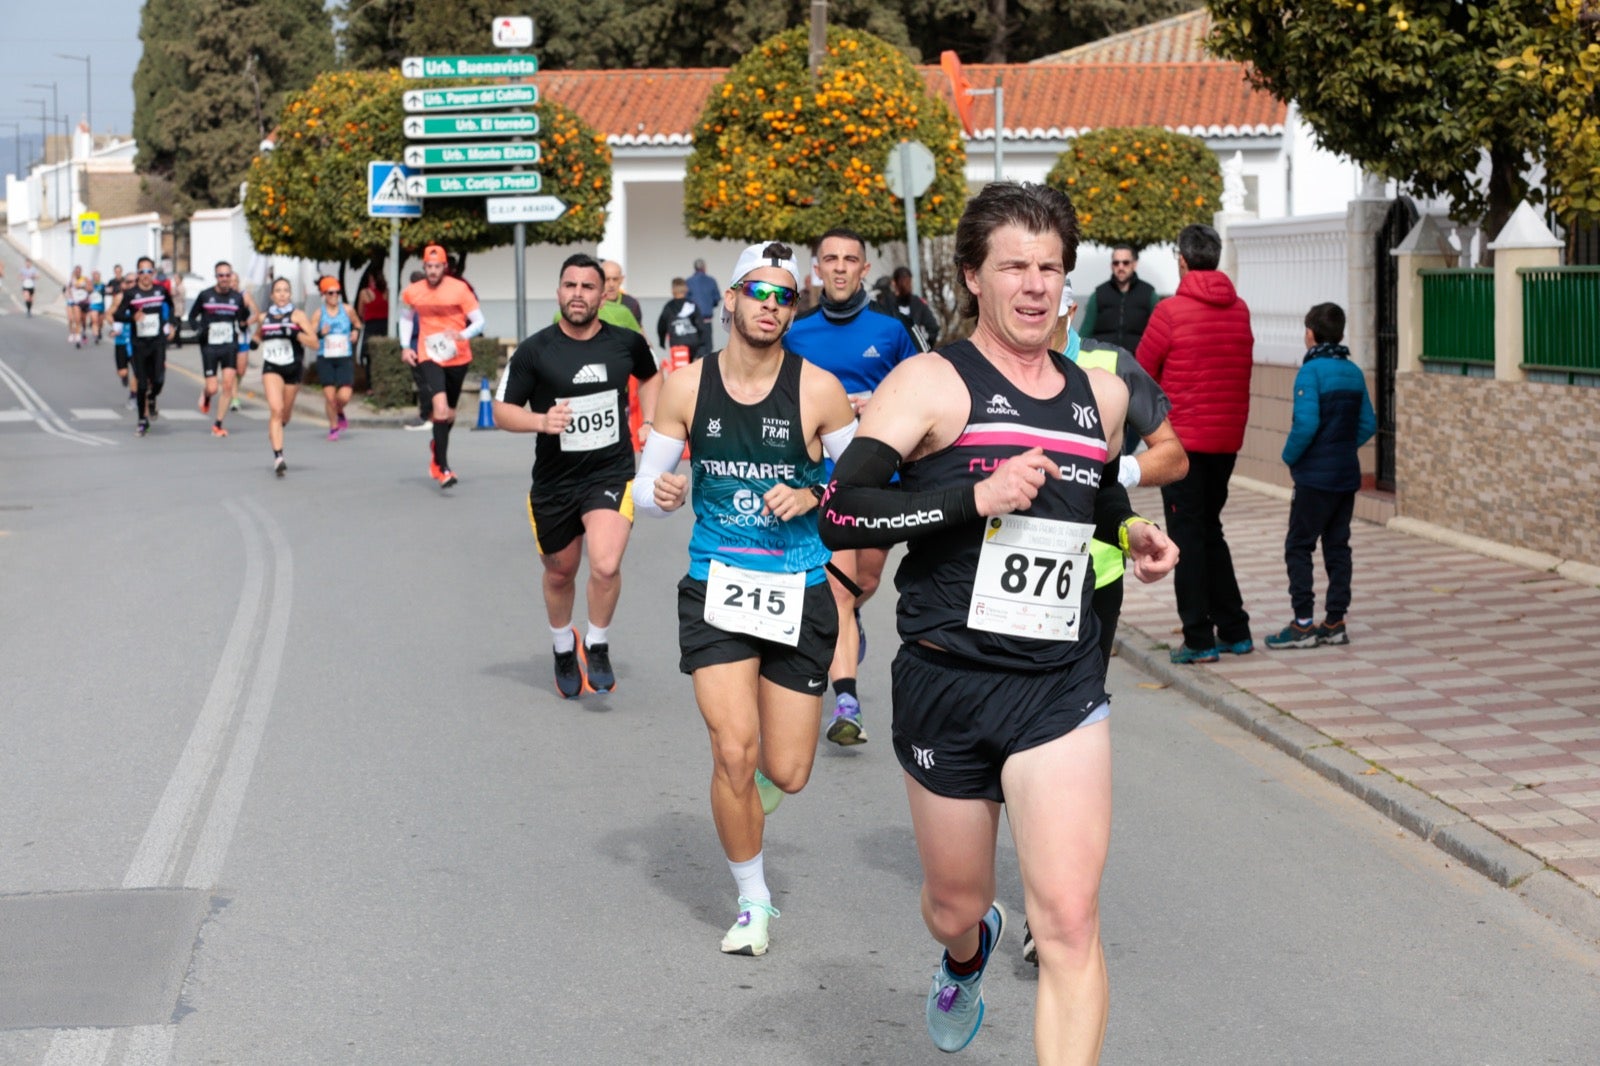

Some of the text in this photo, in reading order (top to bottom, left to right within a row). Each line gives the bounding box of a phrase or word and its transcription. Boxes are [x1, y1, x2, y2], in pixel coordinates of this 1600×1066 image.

[425, 59, 534, 75] Urb. Buenavista
[455, 118, 479, 131] Urb.
[480, 118, 493, 131] El
[442, 149, 465, 162] Urb.
[467, 149, 502, 160] Monte
[440, 178, 463, 191] Urb.
[465, 177, 501, 191] Cortijo
[761, 417, 790, 426] TATTOO
[761, 425, 789, 441] FRAN
[700, 460, 795, 480] TRIATARFE
[1000, 553, 1073, 600] 876
[723, 584, 786, 615] 215
